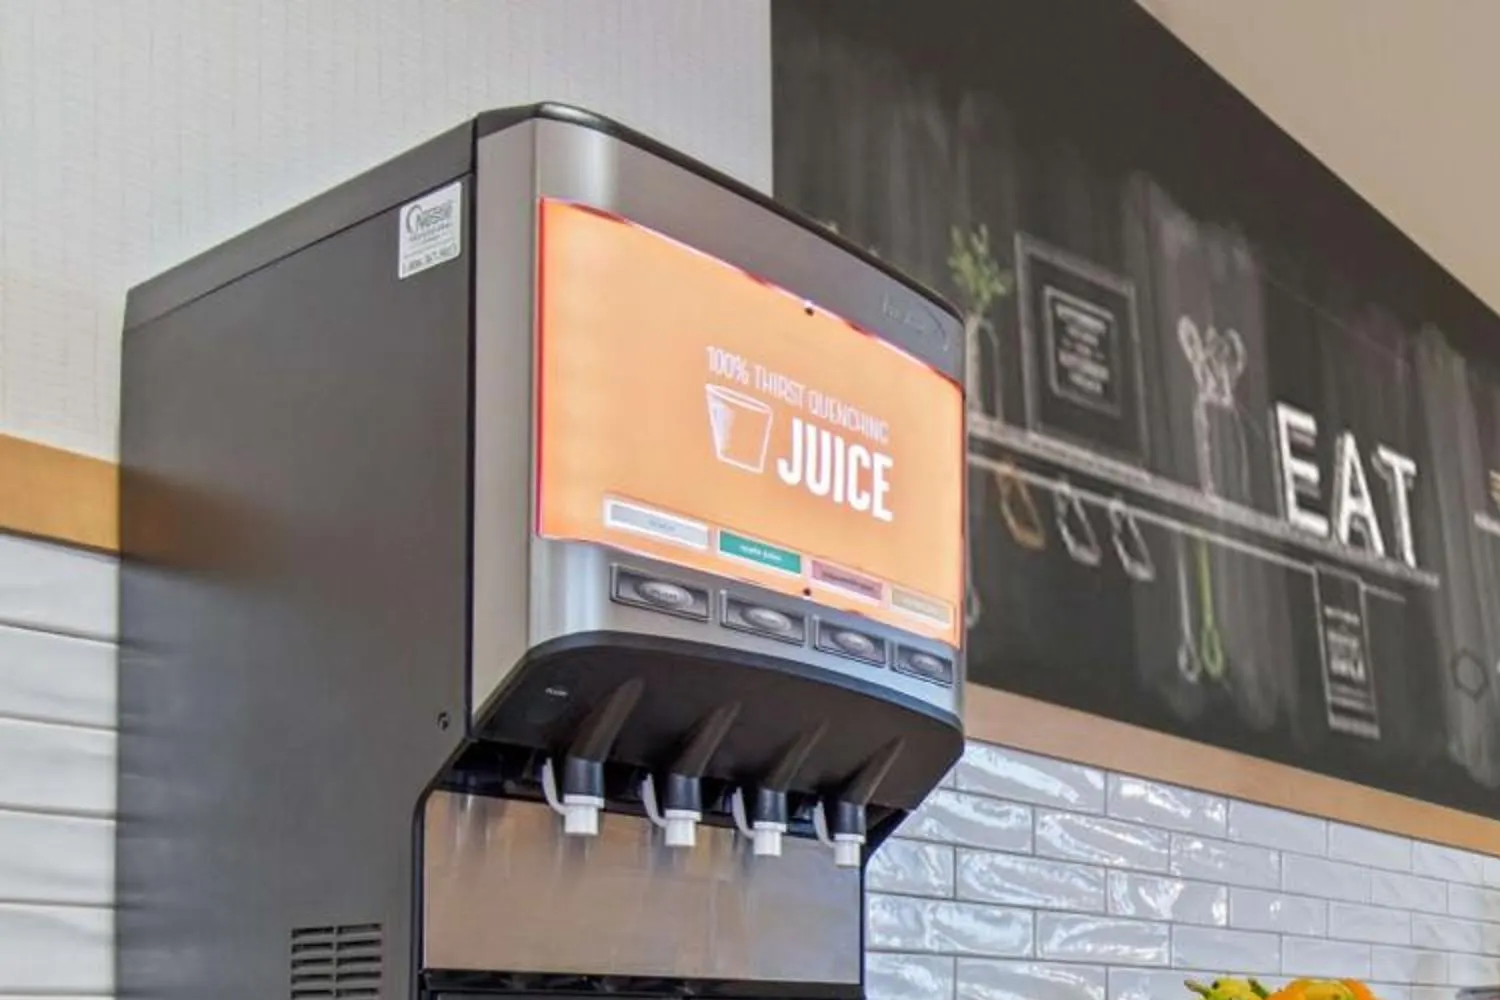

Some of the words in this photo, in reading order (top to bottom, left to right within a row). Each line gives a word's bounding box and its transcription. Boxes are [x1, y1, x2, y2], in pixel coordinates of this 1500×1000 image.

[705, 346, 749, 385] 100%
[754, 364, 806, 408] THIRST
[808, 389, 890, 445] QUENCHING
[777, 416, 894, 521] JUICE
[1270, 401, 1417, 569] EAT
